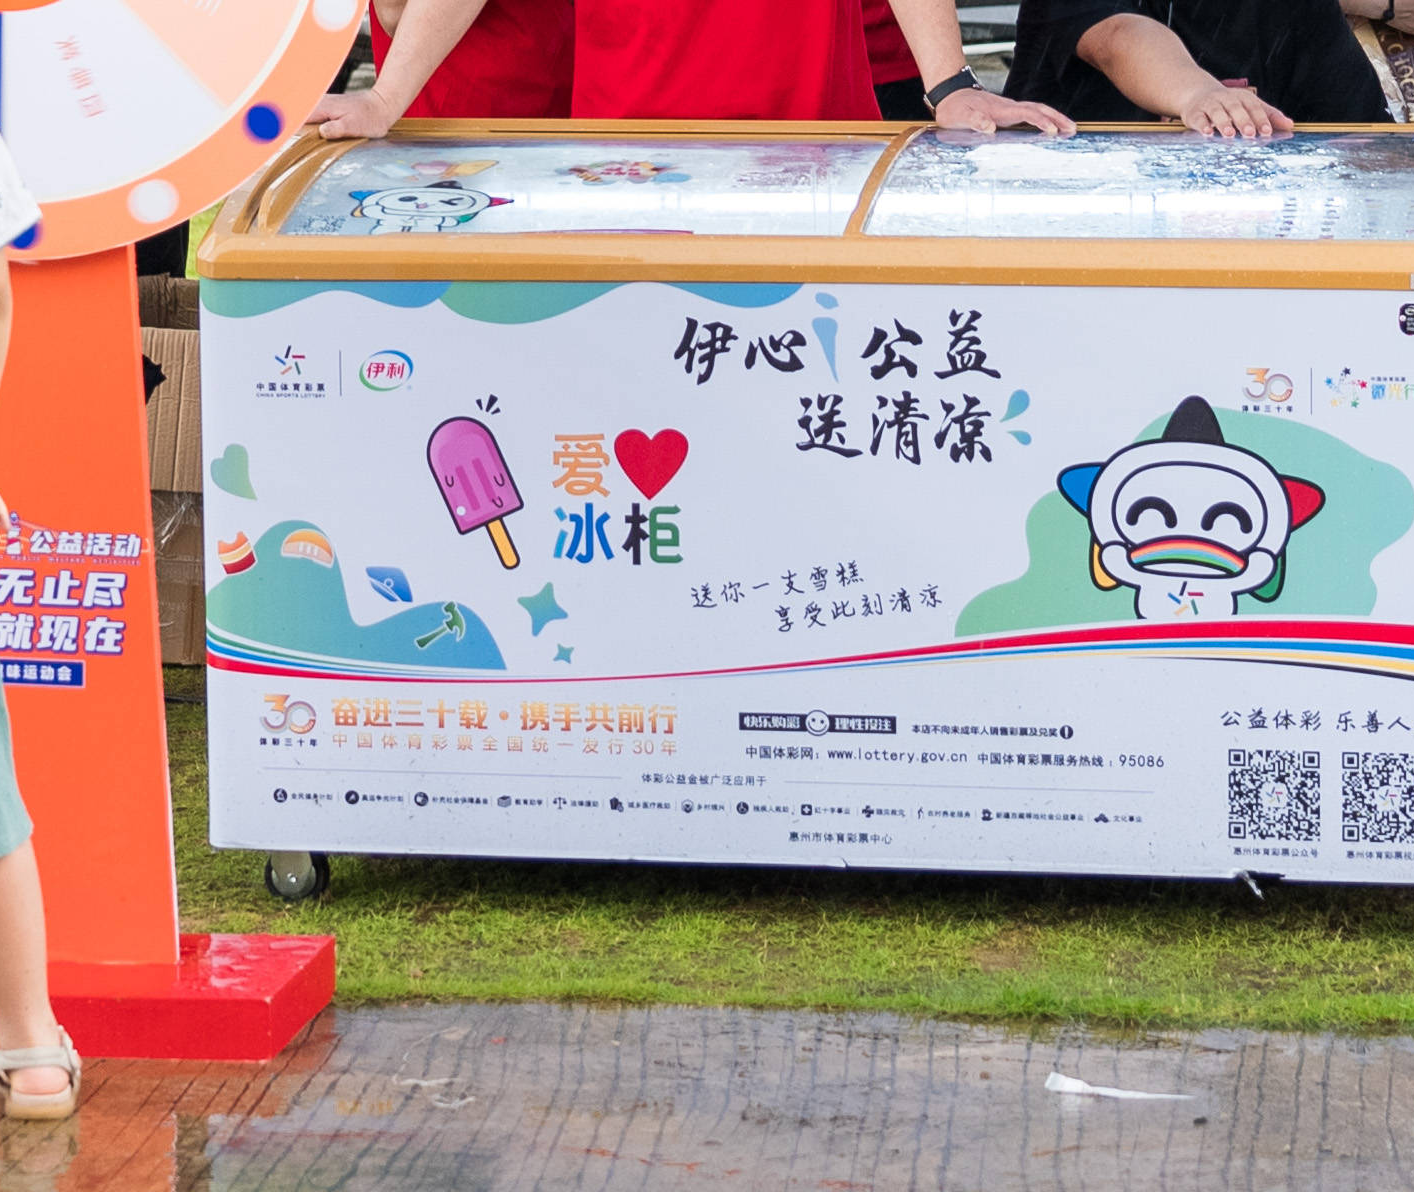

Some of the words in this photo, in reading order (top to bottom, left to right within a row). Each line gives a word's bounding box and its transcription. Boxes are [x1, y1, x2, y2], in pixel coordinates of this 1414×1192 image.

[860, 308, 1002, 380] 公益
[366, 361, 405, 379] 伊利
[256, 382, 325, 392] 中国体育彩票
[795, 390, 993, 466] 送清凉
[552, 433, 611, 498] 爱
[553, 502, 684, 566] 冰柜
[691, 560, 865, 609] 送你一支雪糕
[775, 584, 944, 633] 享受此刻清凉
[2, 662, 73, 683] 味运动会
[1220, 707, 1322, 731] 公益体彩
[332, 732, 678, 756] 中国体育彩票全国统一发行30年
[827, 748, 968, 765] www.lottery.gov.cn
[1119, 753, 1165, 769] 95086
[641, 772, 767, 788] 体彩公益金被广泛应用于
[789, 831, 893, 845] 惠州市体育彩票中心
